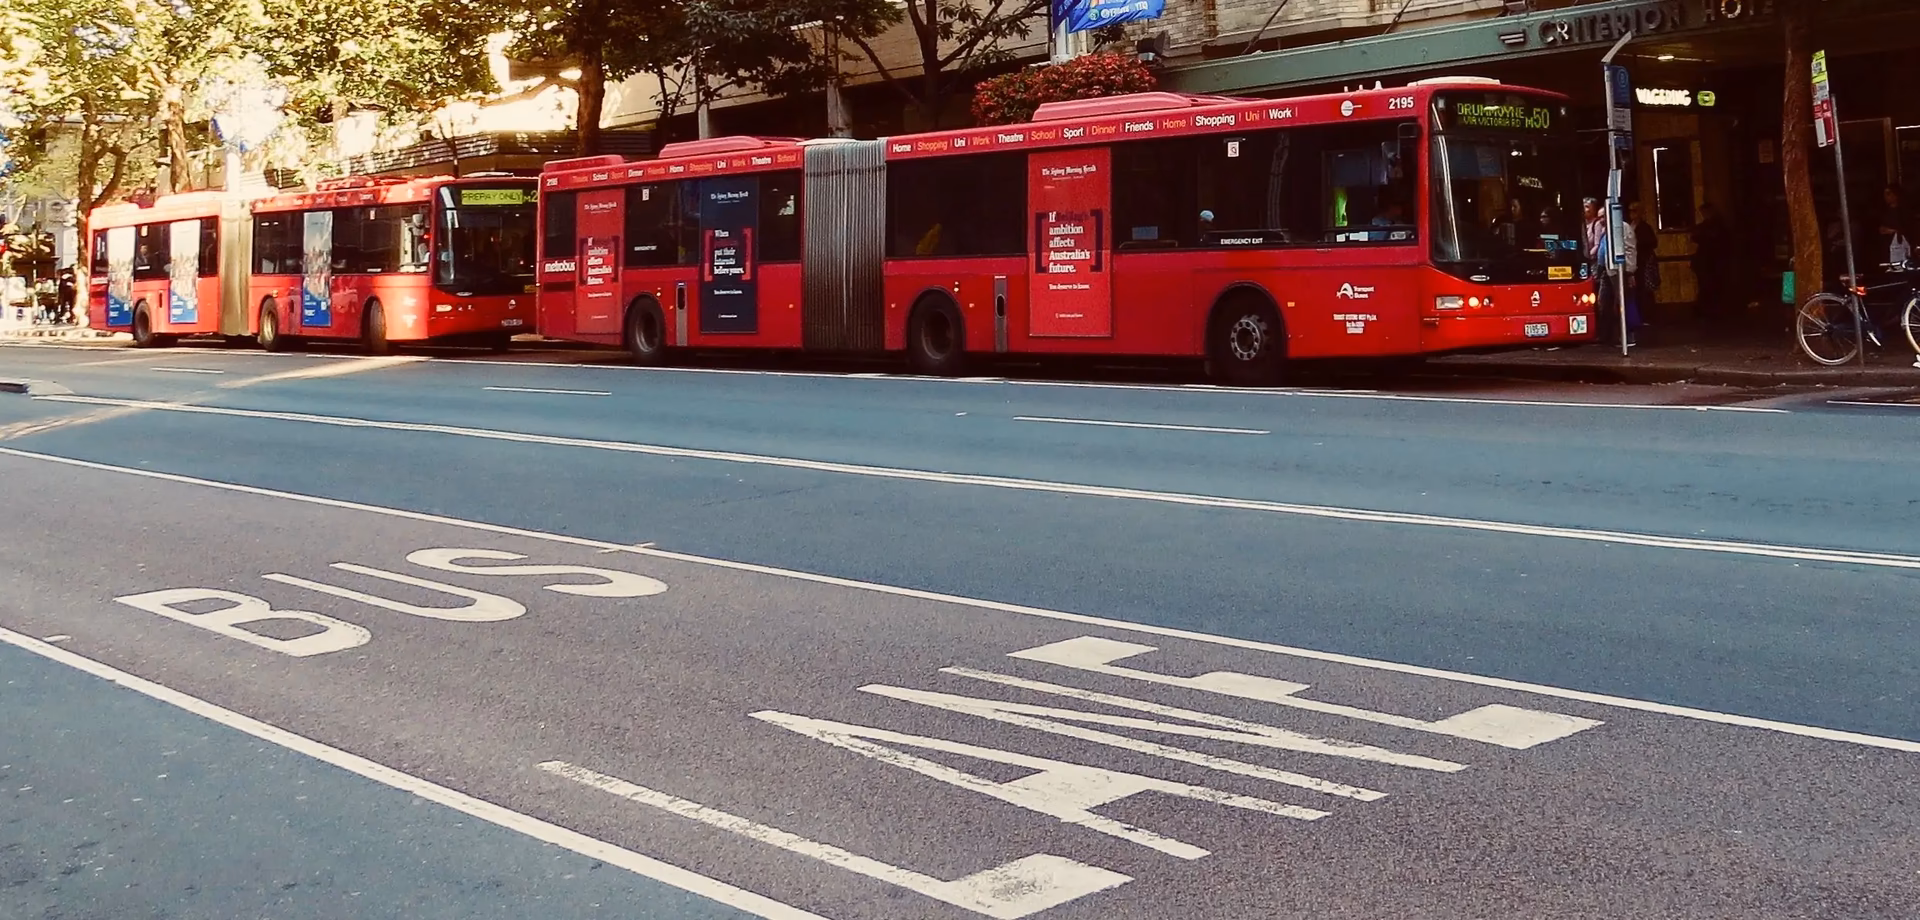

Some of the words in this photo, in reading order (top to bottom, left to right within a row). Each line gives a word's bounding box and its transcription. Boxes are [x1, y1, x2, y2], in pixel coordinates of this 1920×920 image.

[1538, 7, 1682, 44] CRITERION
[1388, 97, 1414, 110] 2195
[1635, 88, 1692, 106] WAGERING
[1457, 103, 1525, 118] DRUMMOYNE
[893, 142, 912, 152] Home
[917, 140, 948, 152] Shopping
[954, 137, 966, 148] Uni
[972, 136, 990, 146] Work
[998, 132, 1024, 144] Theatre
[1031, 129, 1056, 140] School
[1063, 127, 1084, 139] Sport
[1091, 125, 1116, 136] Dinner
[1125, 121, 1154, 132] Friends
[1162, 118, 1187, 129] Home
[1195, 113, 1235, 127] Shopping
[1245, 110, 1260, 121] Uni
[1269, 107, 1292, 119] Work
[717, 160, 726, 169] Uni
[751, 156, 772, 166] Theatre
[462, 192, 496, 201] PREPAY
[499, 192, 522, 201] ONLY
[1049, 212, 1056, 222] If
[1049, 224, 1084, 236] ambition
[1049, 238, 1075, 248] affects
[1049, 250, 1091, 261] Australia's
[545, 261, 576, 272] metrobus
[1049, 263, 1077, 273] future.
[117, 548, 669, 657] BUS
[538, 635, 1603, 919] LANE
